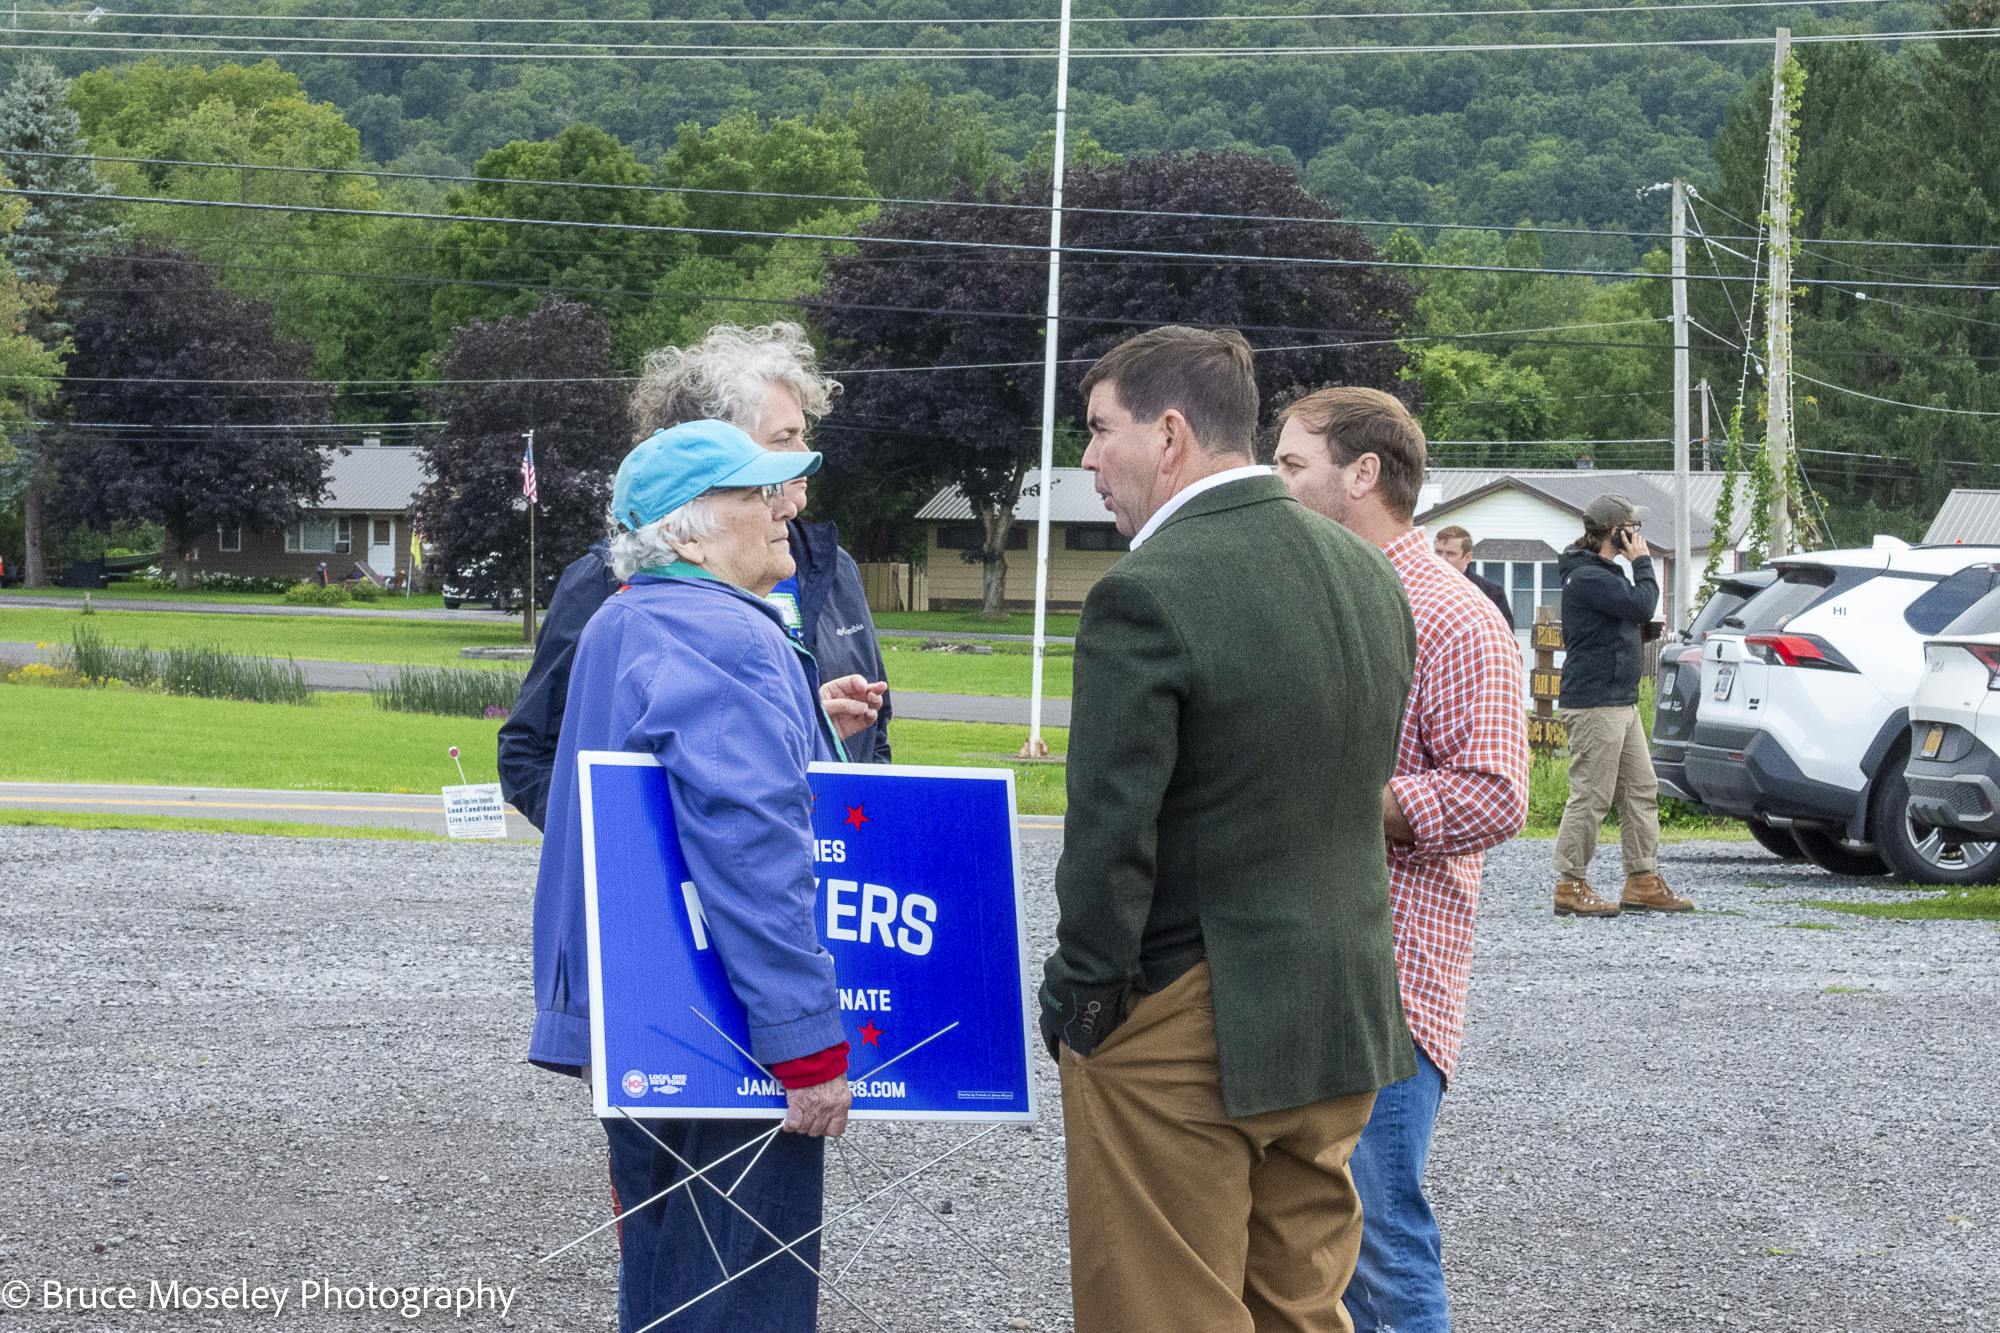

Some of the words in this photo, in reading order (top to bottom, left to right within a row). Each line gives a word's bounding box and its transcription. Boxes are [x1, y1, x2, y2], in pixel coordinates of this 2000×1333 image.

[447, 806, 463, 814] Good
[464, 804, 501, 813] Candidates
[449, 816, 462, 824] Live
[463, 815, 482, 823] Local
[836, 988, 891, 1011] NATE
